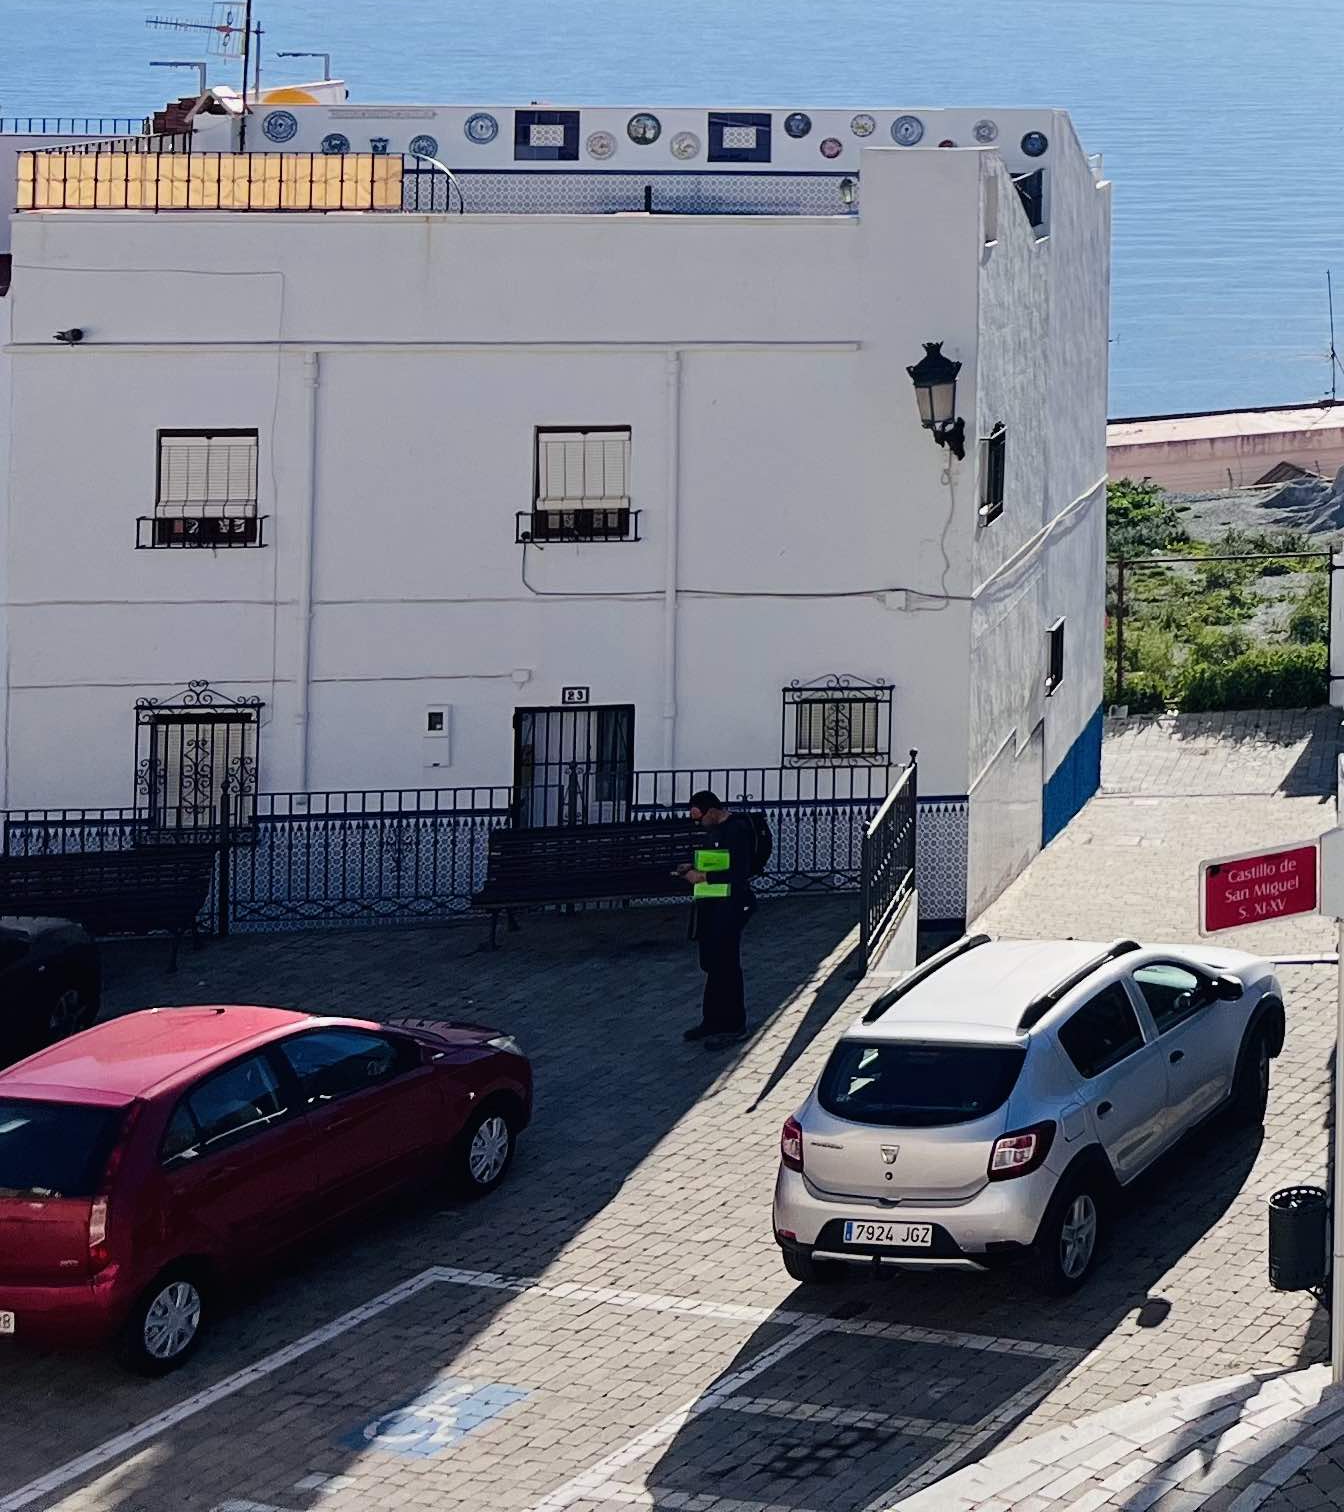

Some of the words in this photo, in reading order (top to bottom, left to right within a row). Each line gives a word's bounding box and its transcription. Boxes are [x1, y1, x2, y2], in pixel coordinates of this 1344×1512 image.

[567, 690, 584, 701] 23
[1227, 863, 1276, 884] Castillo
[1280, 858, 1297, 873] de
[1224, 888, 1249, 904] San
[1253, 875, 1299, 897] Miguel
[1238, 906, 1250, 920] S.
[1254, 897, 1288, 916] XI-XV
[856, 1224, 893, 1242] 7924
[901, 1227, 930, 1243] JGZ
